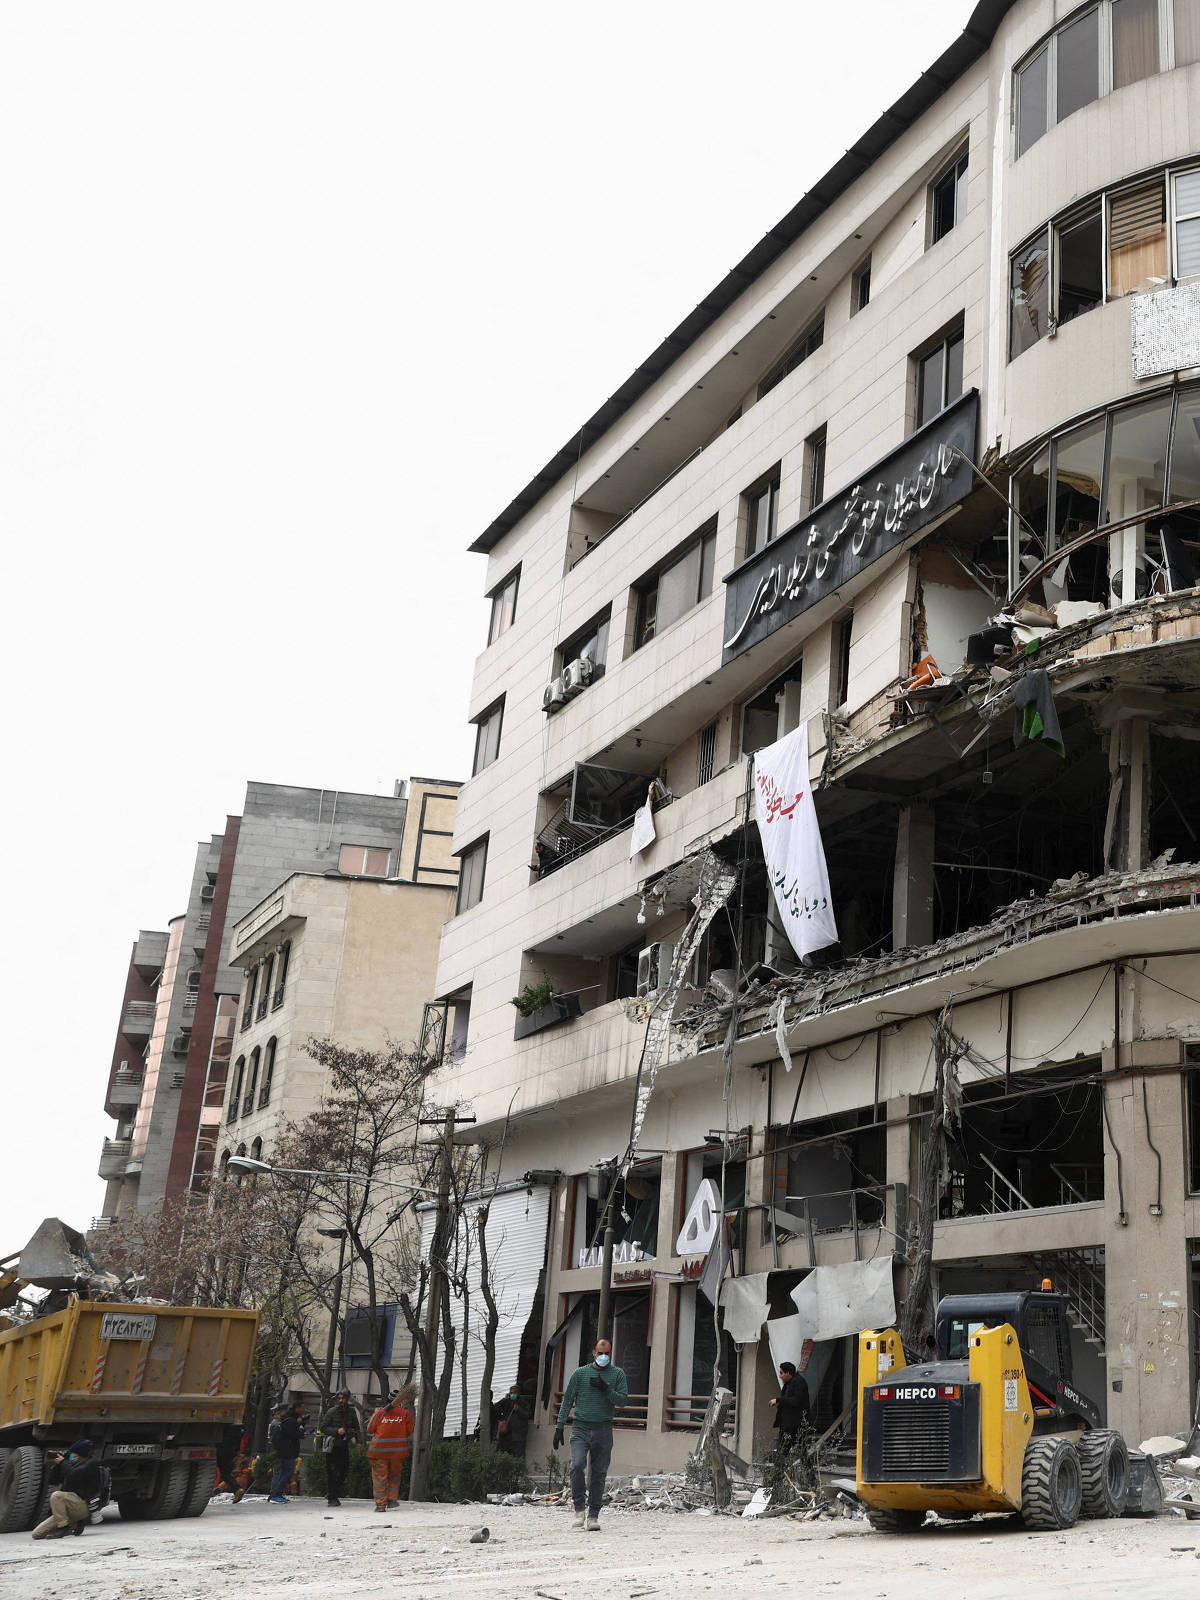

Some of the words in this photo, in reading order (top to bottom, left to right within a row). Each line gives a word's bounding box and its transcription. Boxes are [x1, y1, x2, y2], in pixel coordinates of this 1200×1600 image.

[884, 462, 926, 533] زیبایی
[919, 443, 961, 510] سالن
[852, 482, 886, 556] فوق
[895, 1387, 937, 1401] HEPCO
[1064, 1386, 1079, 1404] HEPCO
